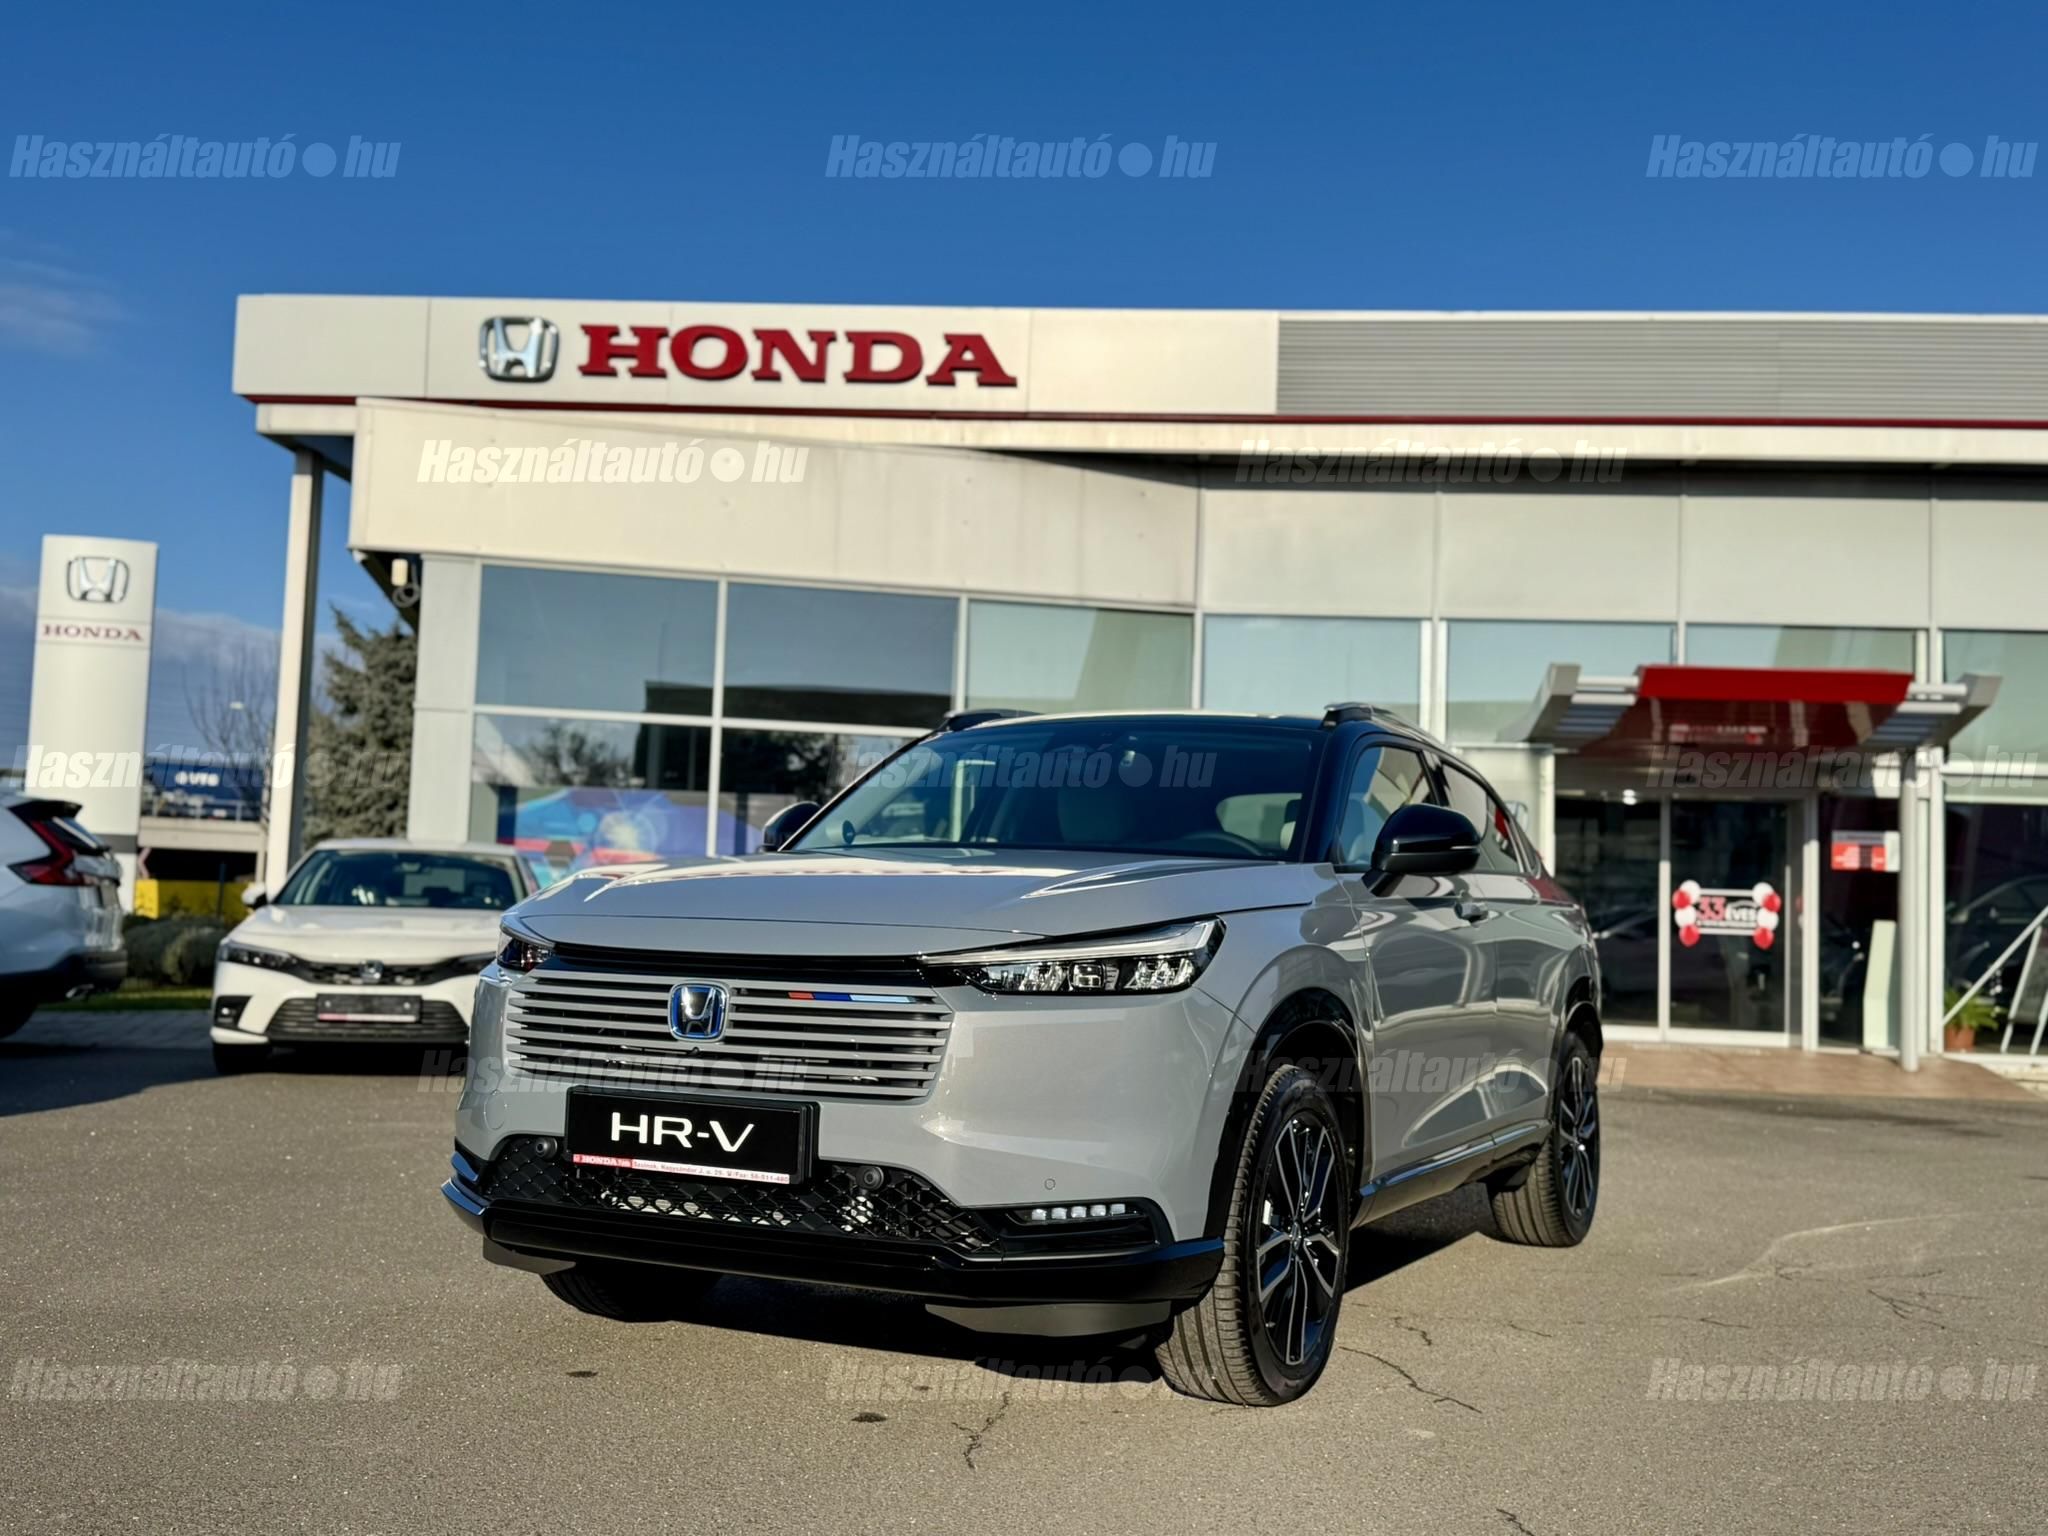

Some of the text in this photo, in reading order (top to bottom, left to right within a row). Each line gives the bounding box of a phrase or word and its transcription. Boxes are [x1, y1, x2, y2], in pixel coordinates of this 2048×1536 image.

[578, 324, 1017, 388] HONDA
[43, 624, 142, 641] HONDA
[611, 1112, 755, 1152] HR-V
